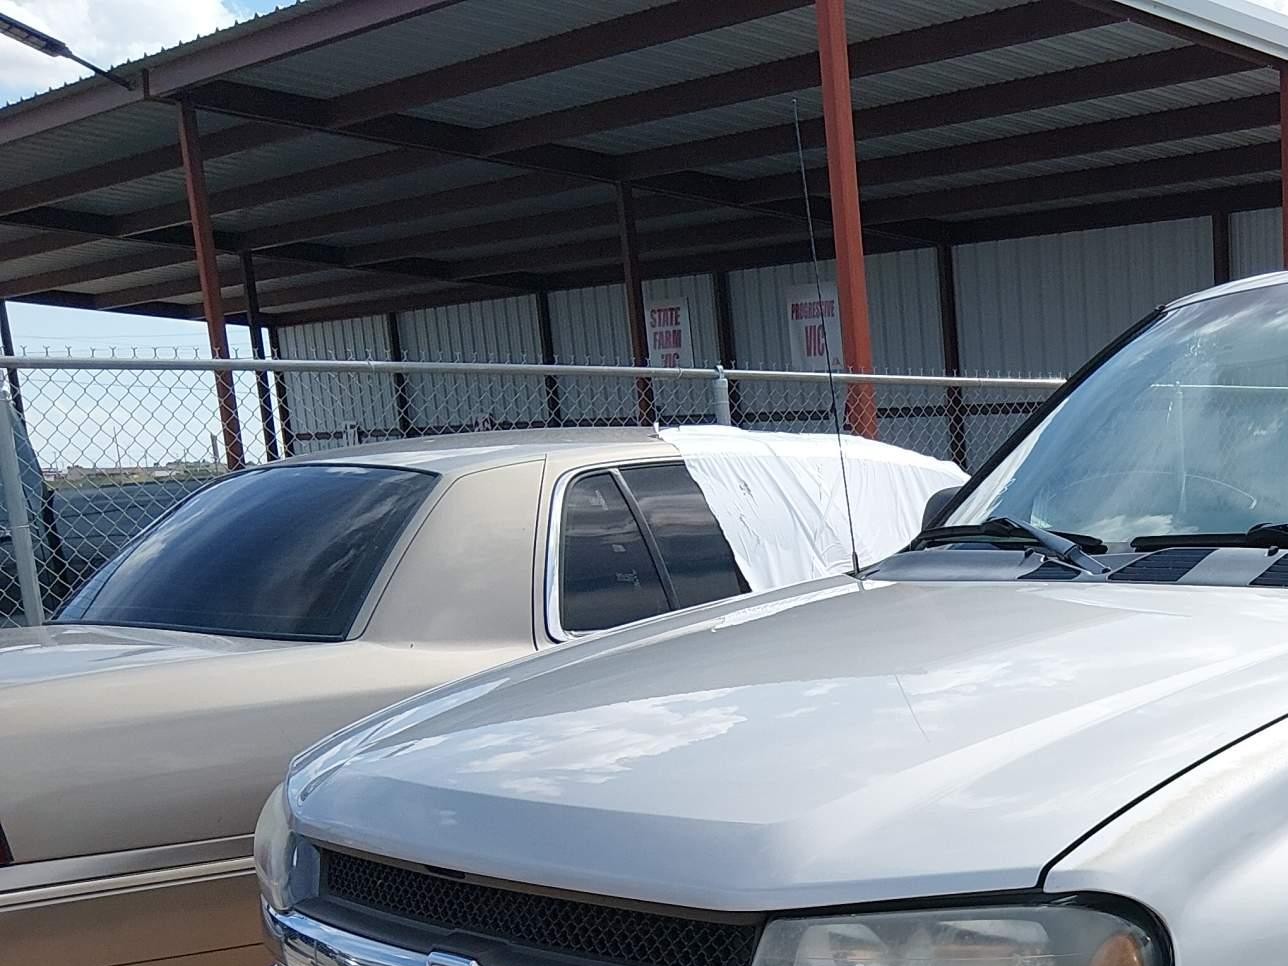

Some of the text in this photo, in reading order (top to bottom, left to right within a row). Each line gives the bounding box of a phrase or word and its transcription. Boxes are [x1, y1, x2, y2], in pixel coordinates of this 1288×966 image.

[650, 307, 680, 328] STATE
[653, 330, 682, 350] FARM
[805, 324, 825, 357] VIC
